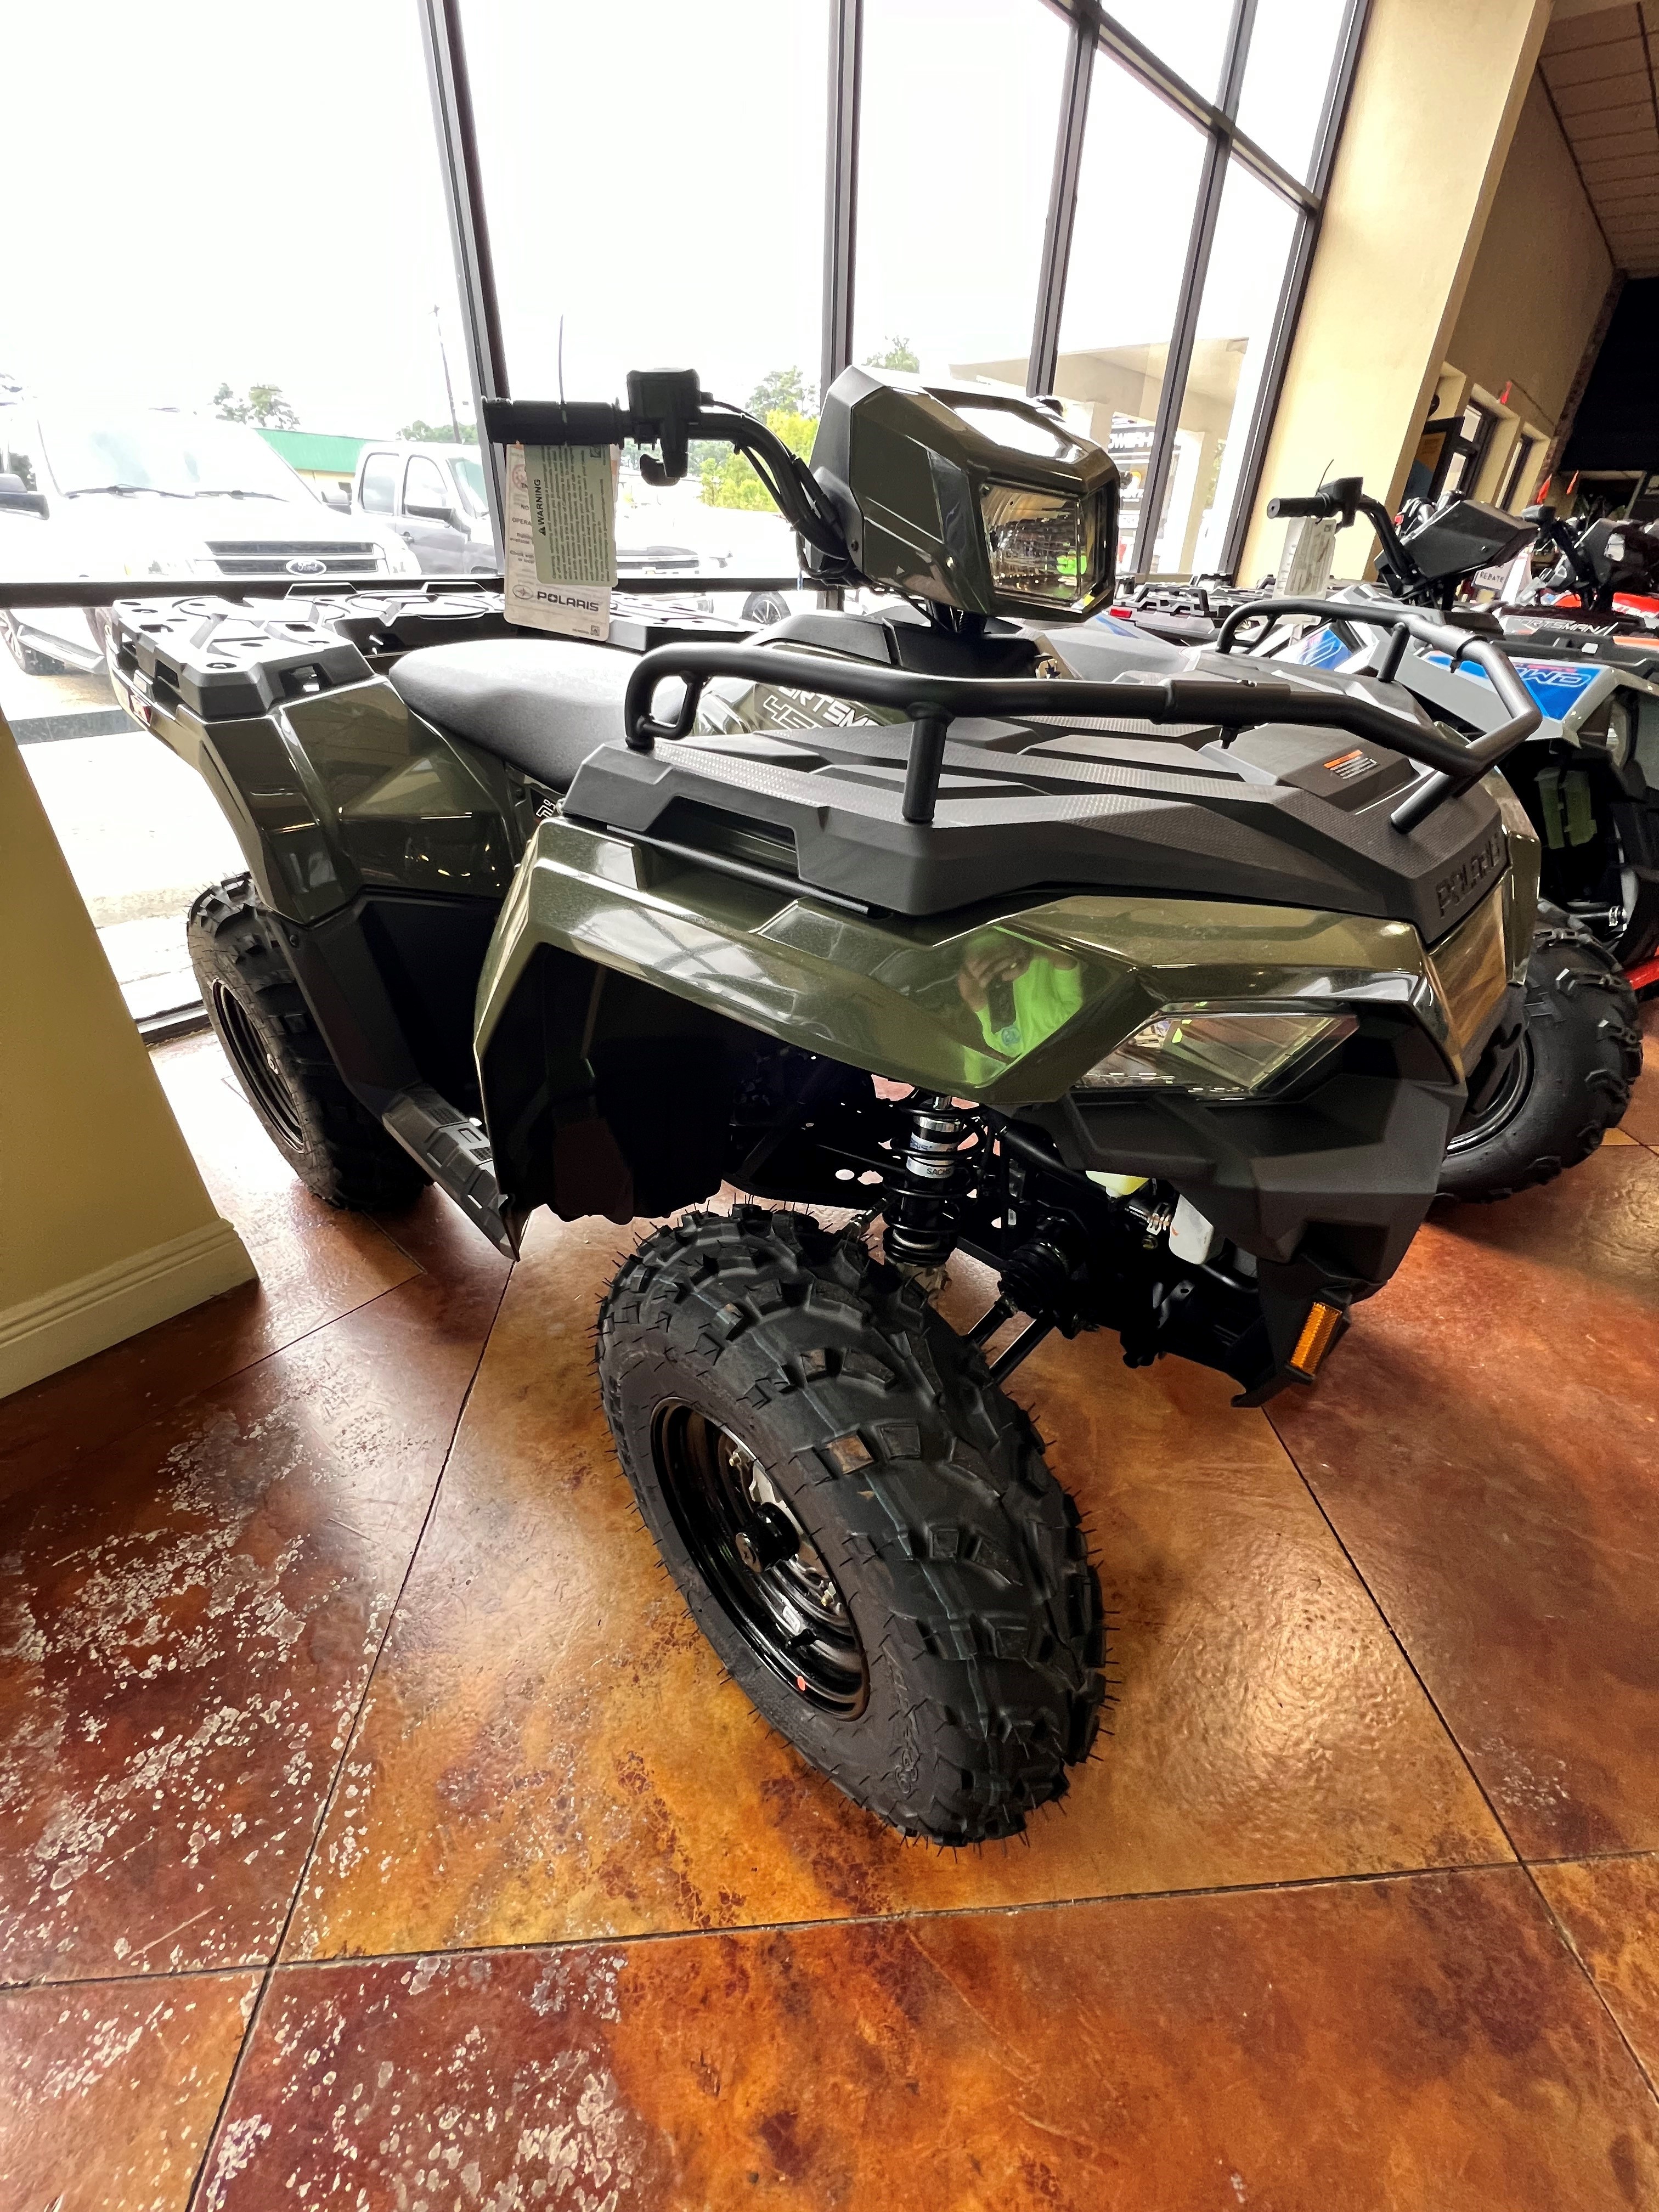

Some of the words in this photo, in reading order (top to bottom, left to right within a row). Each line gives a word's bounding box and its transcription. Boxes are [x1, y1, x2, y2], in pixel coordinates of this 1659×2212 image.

[534, 479, 545, 526] WARNING
[1480, 571, 1504, 583] REBATE
[537, 591, 599, 612] POLARIS
